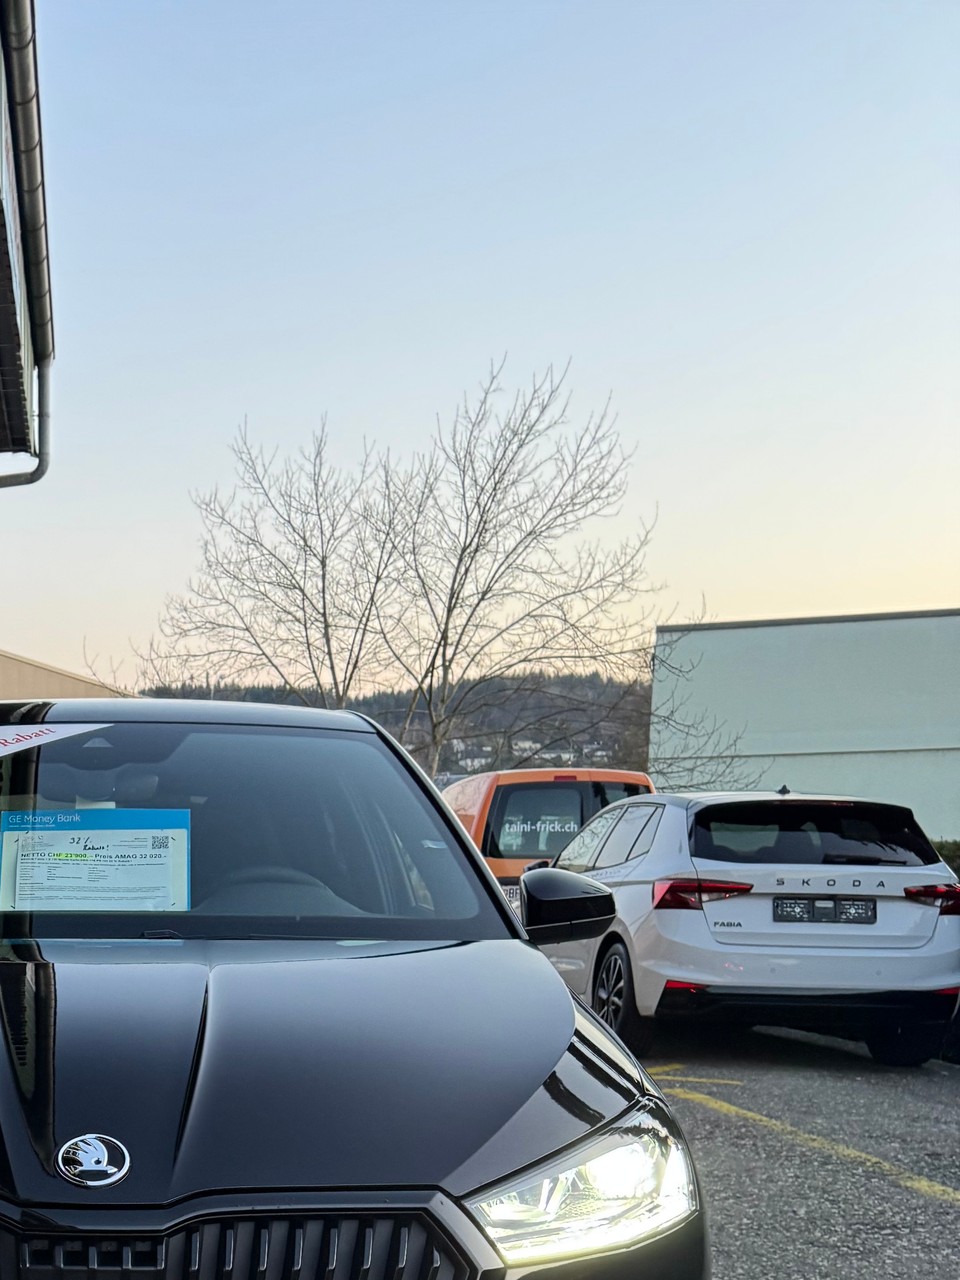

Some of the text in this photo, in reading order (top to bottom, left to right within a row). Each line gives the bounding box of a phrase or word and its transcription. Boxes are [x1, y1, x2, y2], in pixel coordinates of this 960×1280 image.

[8, 813, 81, 824] GE Money Bank
[504, 821, 578, 832] taini-frick.ch
[776, 879, 886, 889] SKODA
